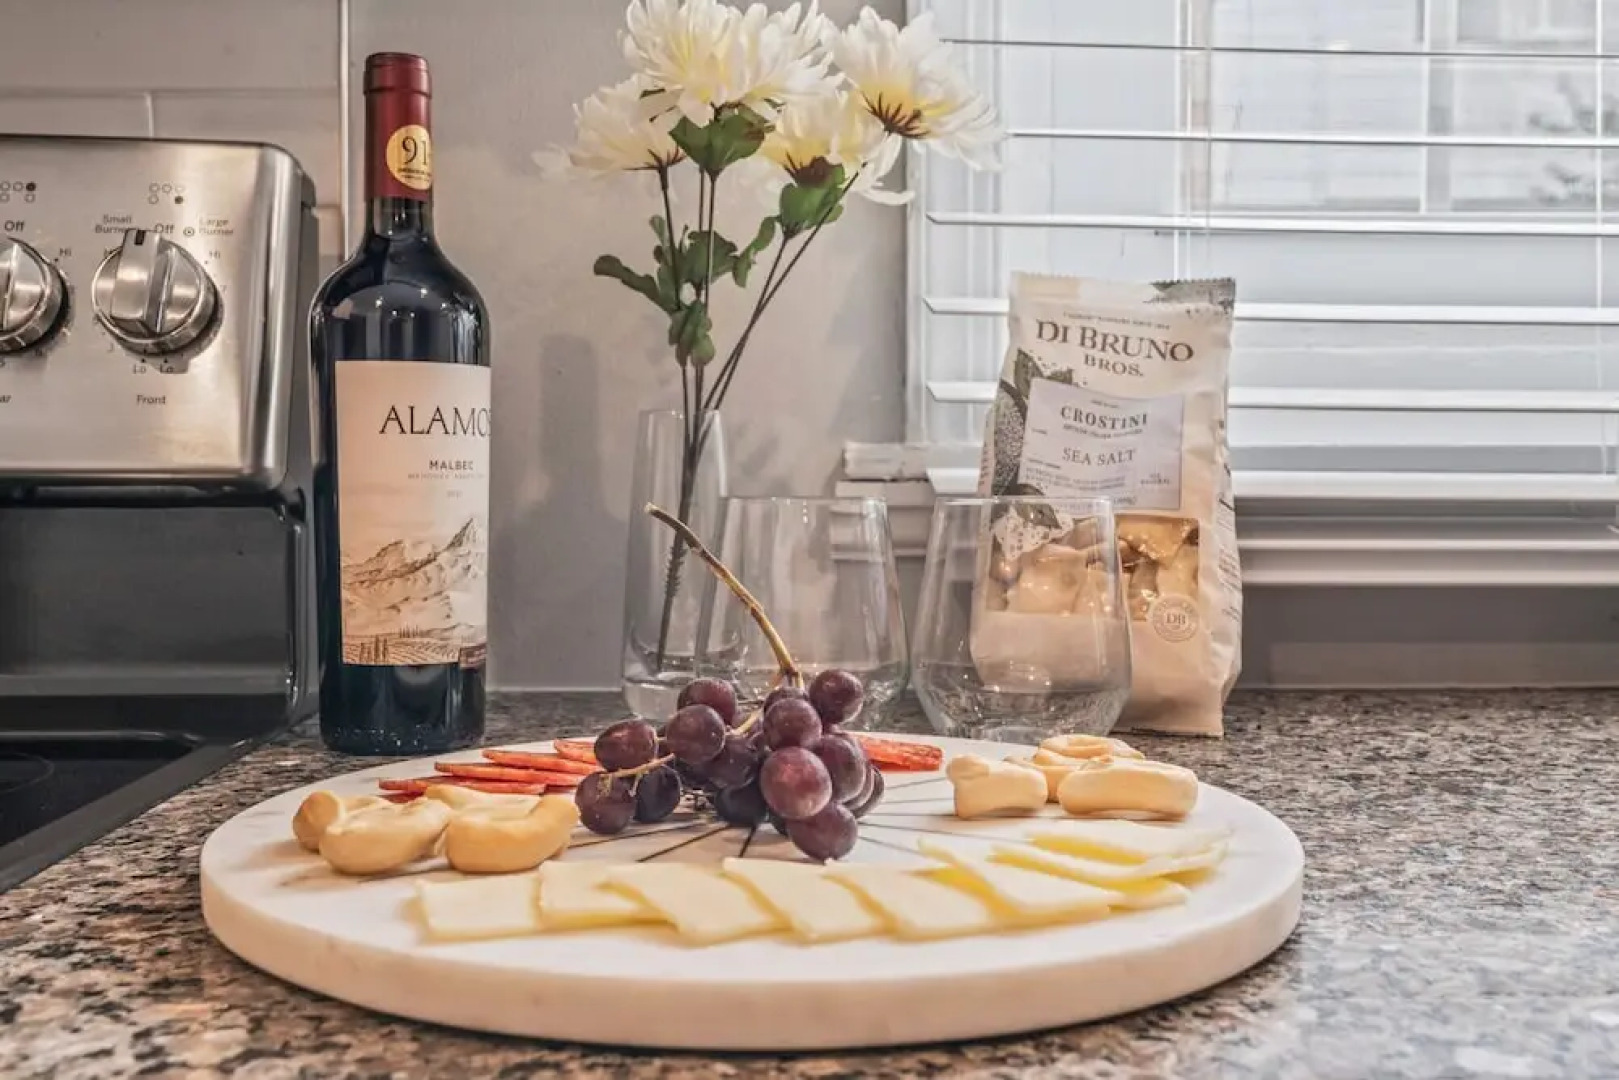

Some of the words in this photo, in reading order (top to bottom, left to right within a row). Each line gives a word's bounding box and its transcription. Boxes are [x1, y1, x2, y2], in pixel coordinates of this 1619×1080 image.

[401, 135, 428, 166] 91
[103, 214, 132, 223] Small
[200, 217, 230, 227] Large
[4, 220, 25, 232] Off
[94, 224, 128, 234] Burne
[154, 223, 176, 234] Off
[1036, 318, 1069, 344] DI
[1079, 325, 1194, 362] BRUNO
[1084, 353, 1144, 377] BROS.
[136, 395, 166, 405] Front
[378, 404, 492, 438] ALAMO
[1060, 405, 1148, 430] CROSTINI
[1062, 447, 1092, 467] SEA
[1097, 448, 1136, 467] SALT
[429, 459, 474, 471] MALBEC
